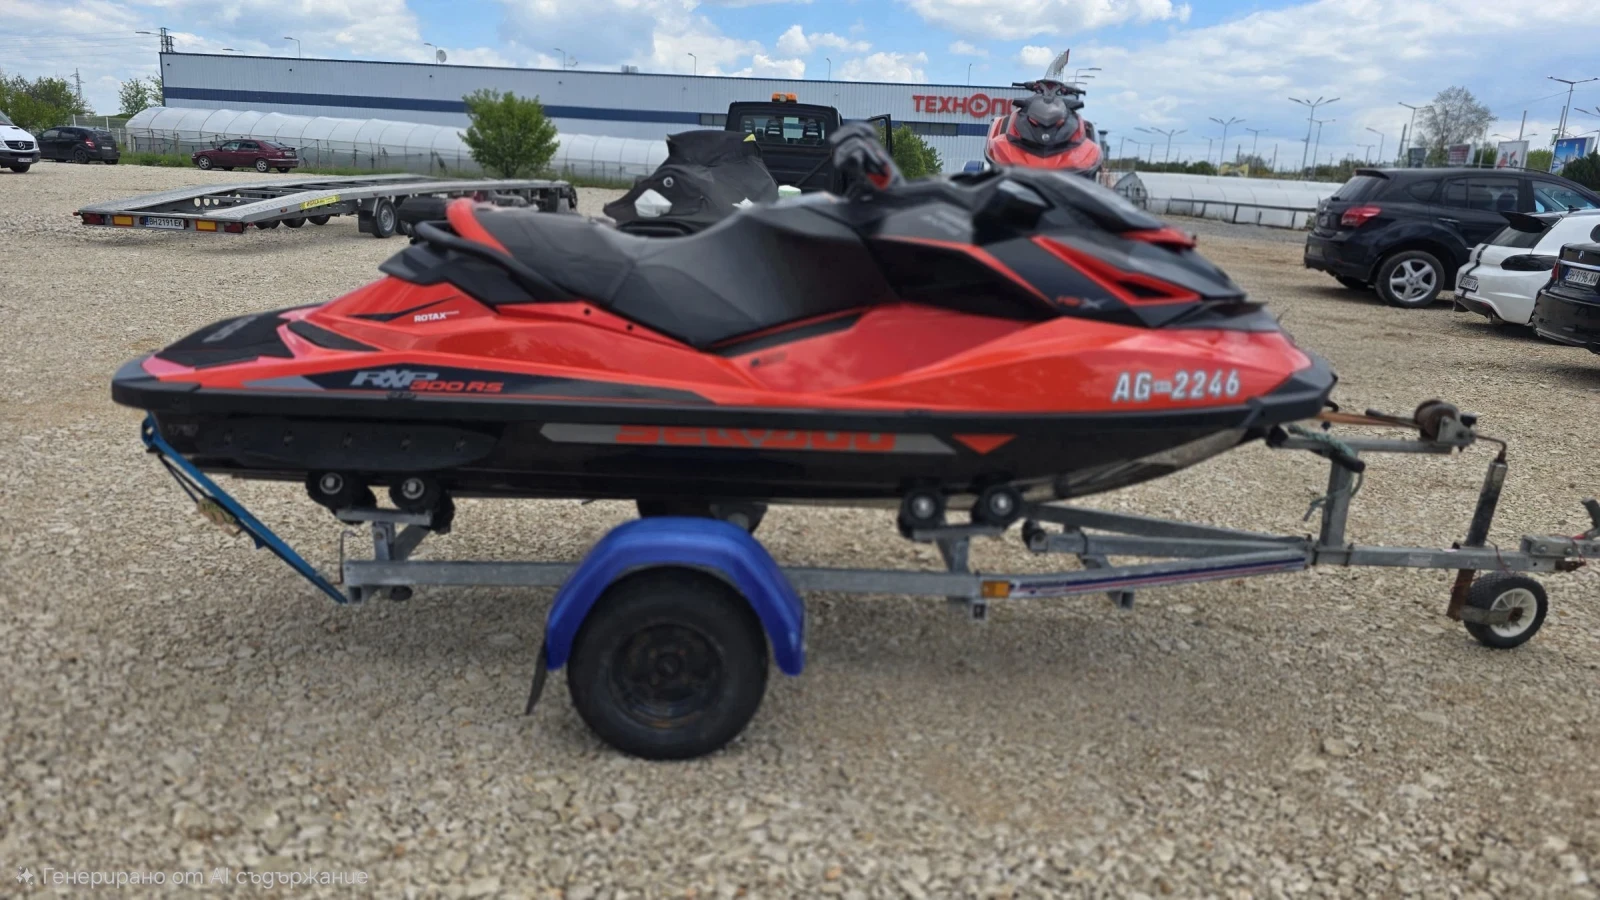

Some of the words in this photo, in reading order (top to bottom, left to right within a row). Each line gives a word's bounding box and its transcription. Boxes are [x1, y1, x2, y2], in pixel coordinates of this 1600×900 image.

[912, 93, 1014, 118] ТЕХНОП
[413, 311, 447, 322] ROTAX
[351, 369, 438, 388] RXP
[409, 380, 462, 392] 300
[465, 382, 504, 393] RS
